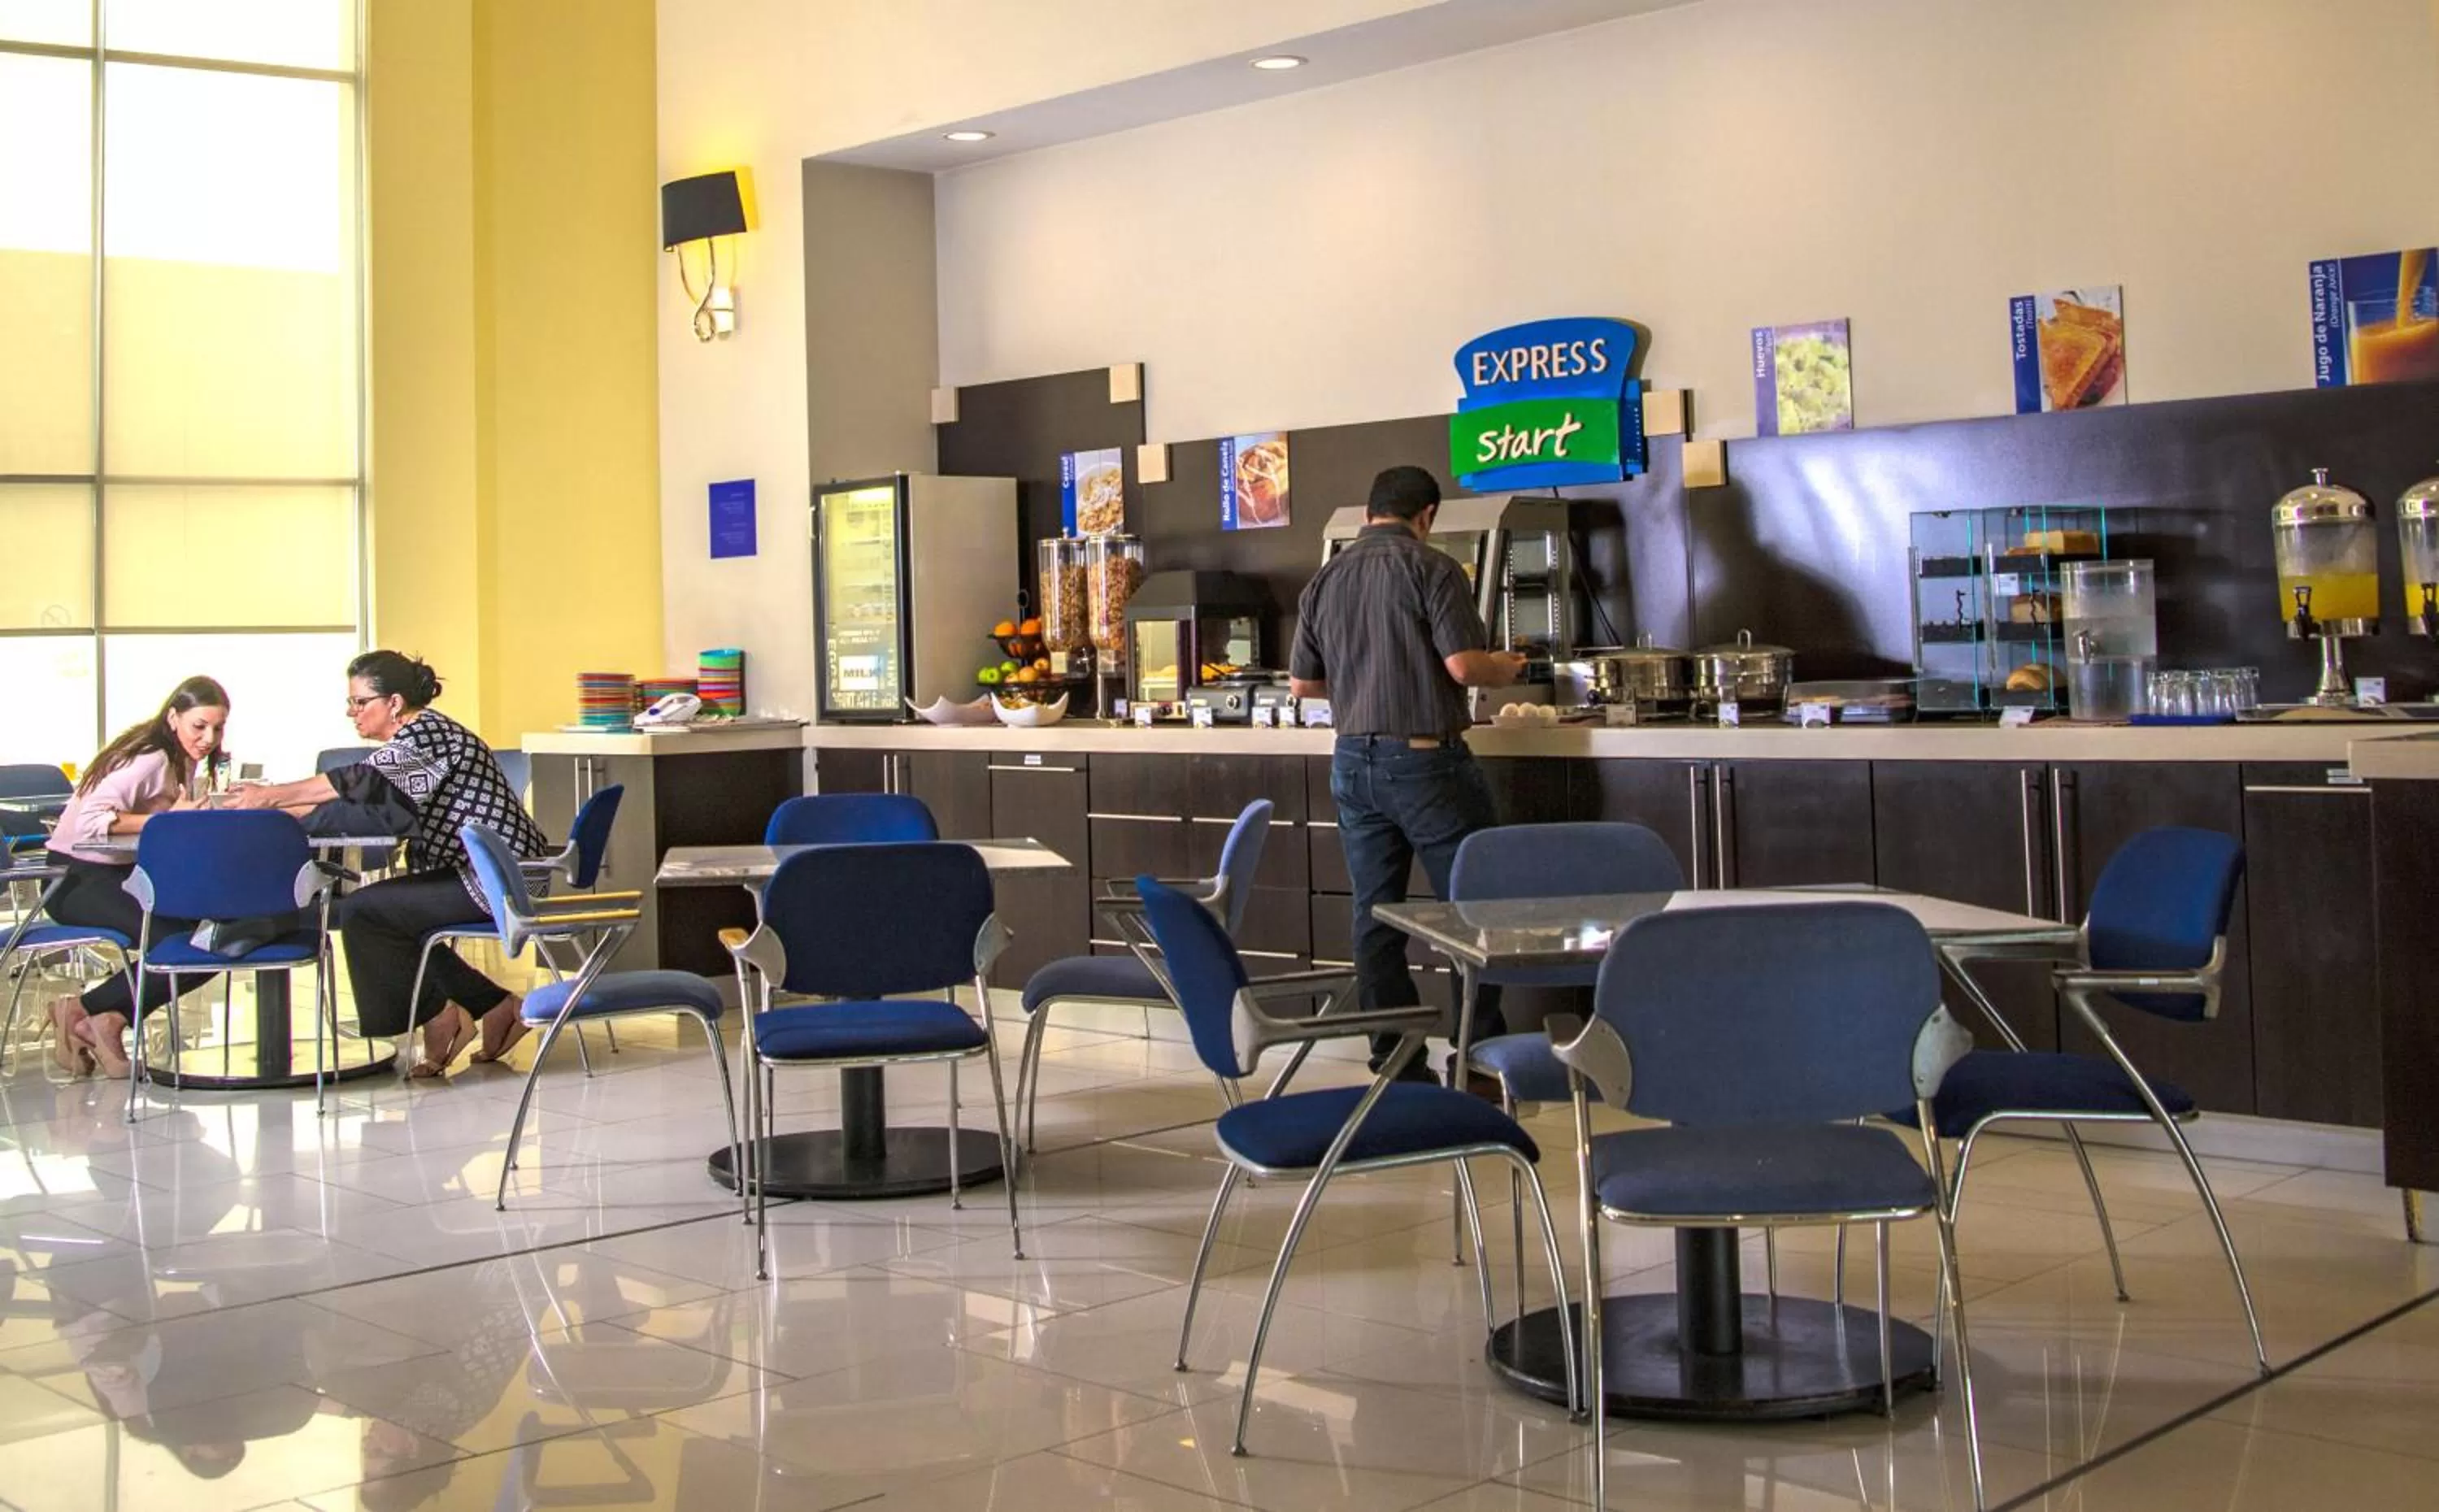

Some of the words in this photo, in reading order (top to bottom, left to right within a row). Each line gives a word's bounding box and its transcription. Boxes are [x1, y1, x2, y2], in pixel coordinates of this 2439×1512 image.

[2312, 265, 2327, 322] Naranja
[2013, 300, 2027, 361] Tostadas
[2315, 325, 2328, 343] de
[1472, 338, 1608, 386] EXPRESS
[1754, 331, 1766, 378] Huevos
[2317, 346, 2332, 382] Jugo
[1222, 479, 1229, 493] de
